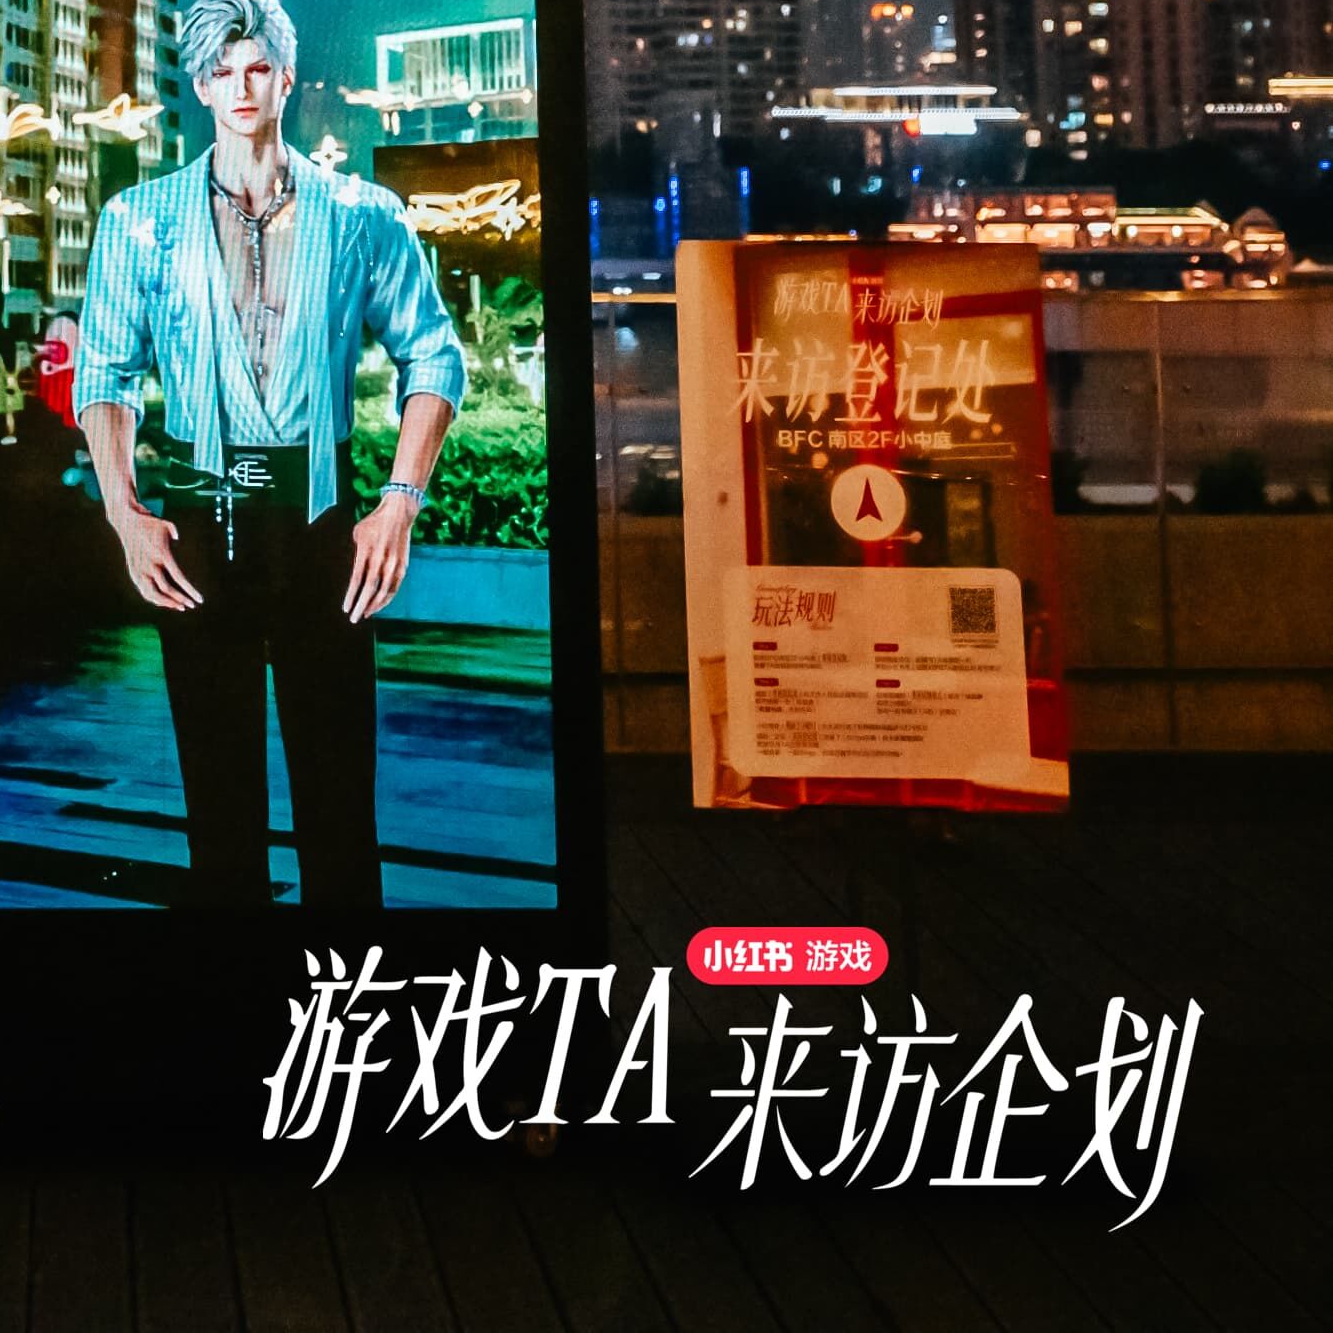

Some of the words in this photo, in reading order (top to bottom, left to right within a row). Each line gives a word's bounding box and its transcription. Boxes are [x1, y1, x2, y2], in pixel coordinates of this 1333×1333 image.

[774, 276, 849, 322] 游戏TA
[853, 287, 945, 332] 来访企划
[730, 337, 996, 425] 来访登记处
[777, 429, 823, 448] BFC
[828, 429, 953, 450] 南区2F小中庭
[751, 588, 837, 628] 玩法规则
